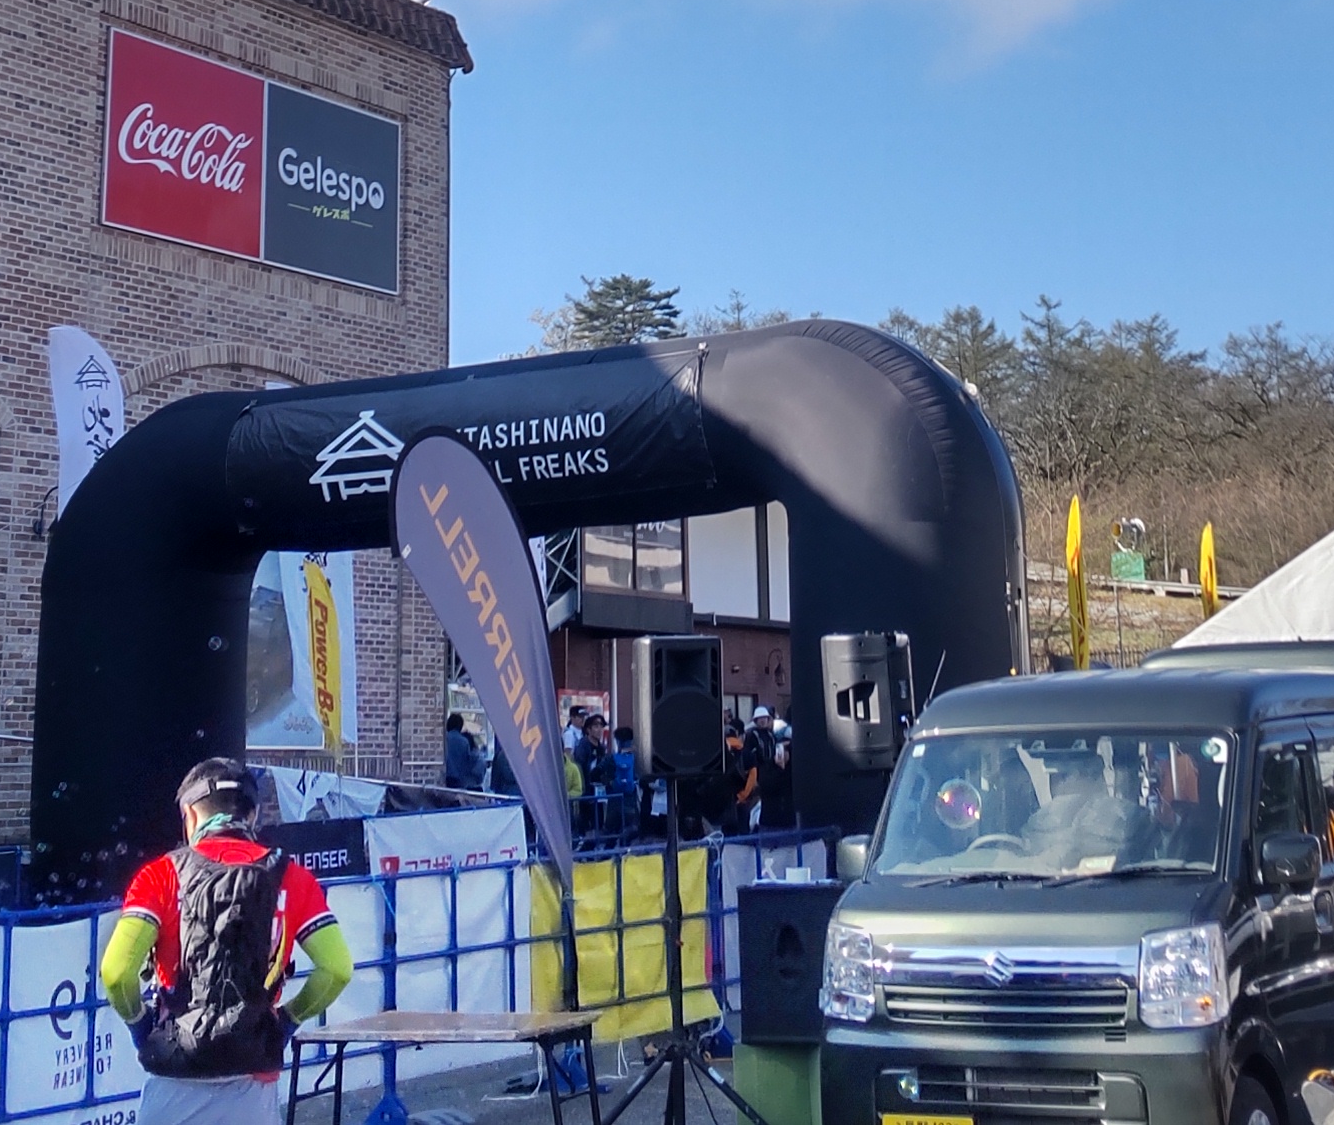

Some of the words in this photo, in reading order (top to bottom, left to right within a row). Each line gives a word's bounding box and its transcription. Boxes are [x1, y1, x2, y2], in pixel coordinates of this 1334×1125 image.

[118, 103, 254, 193] Coca-Cola
[278, 147, 385, 211] Gelespo
[456, 411, 606, 451] TASHINANO
[518, 448, 610, 481] FREAKS
[314, 597, 335, 728] PowerBa
